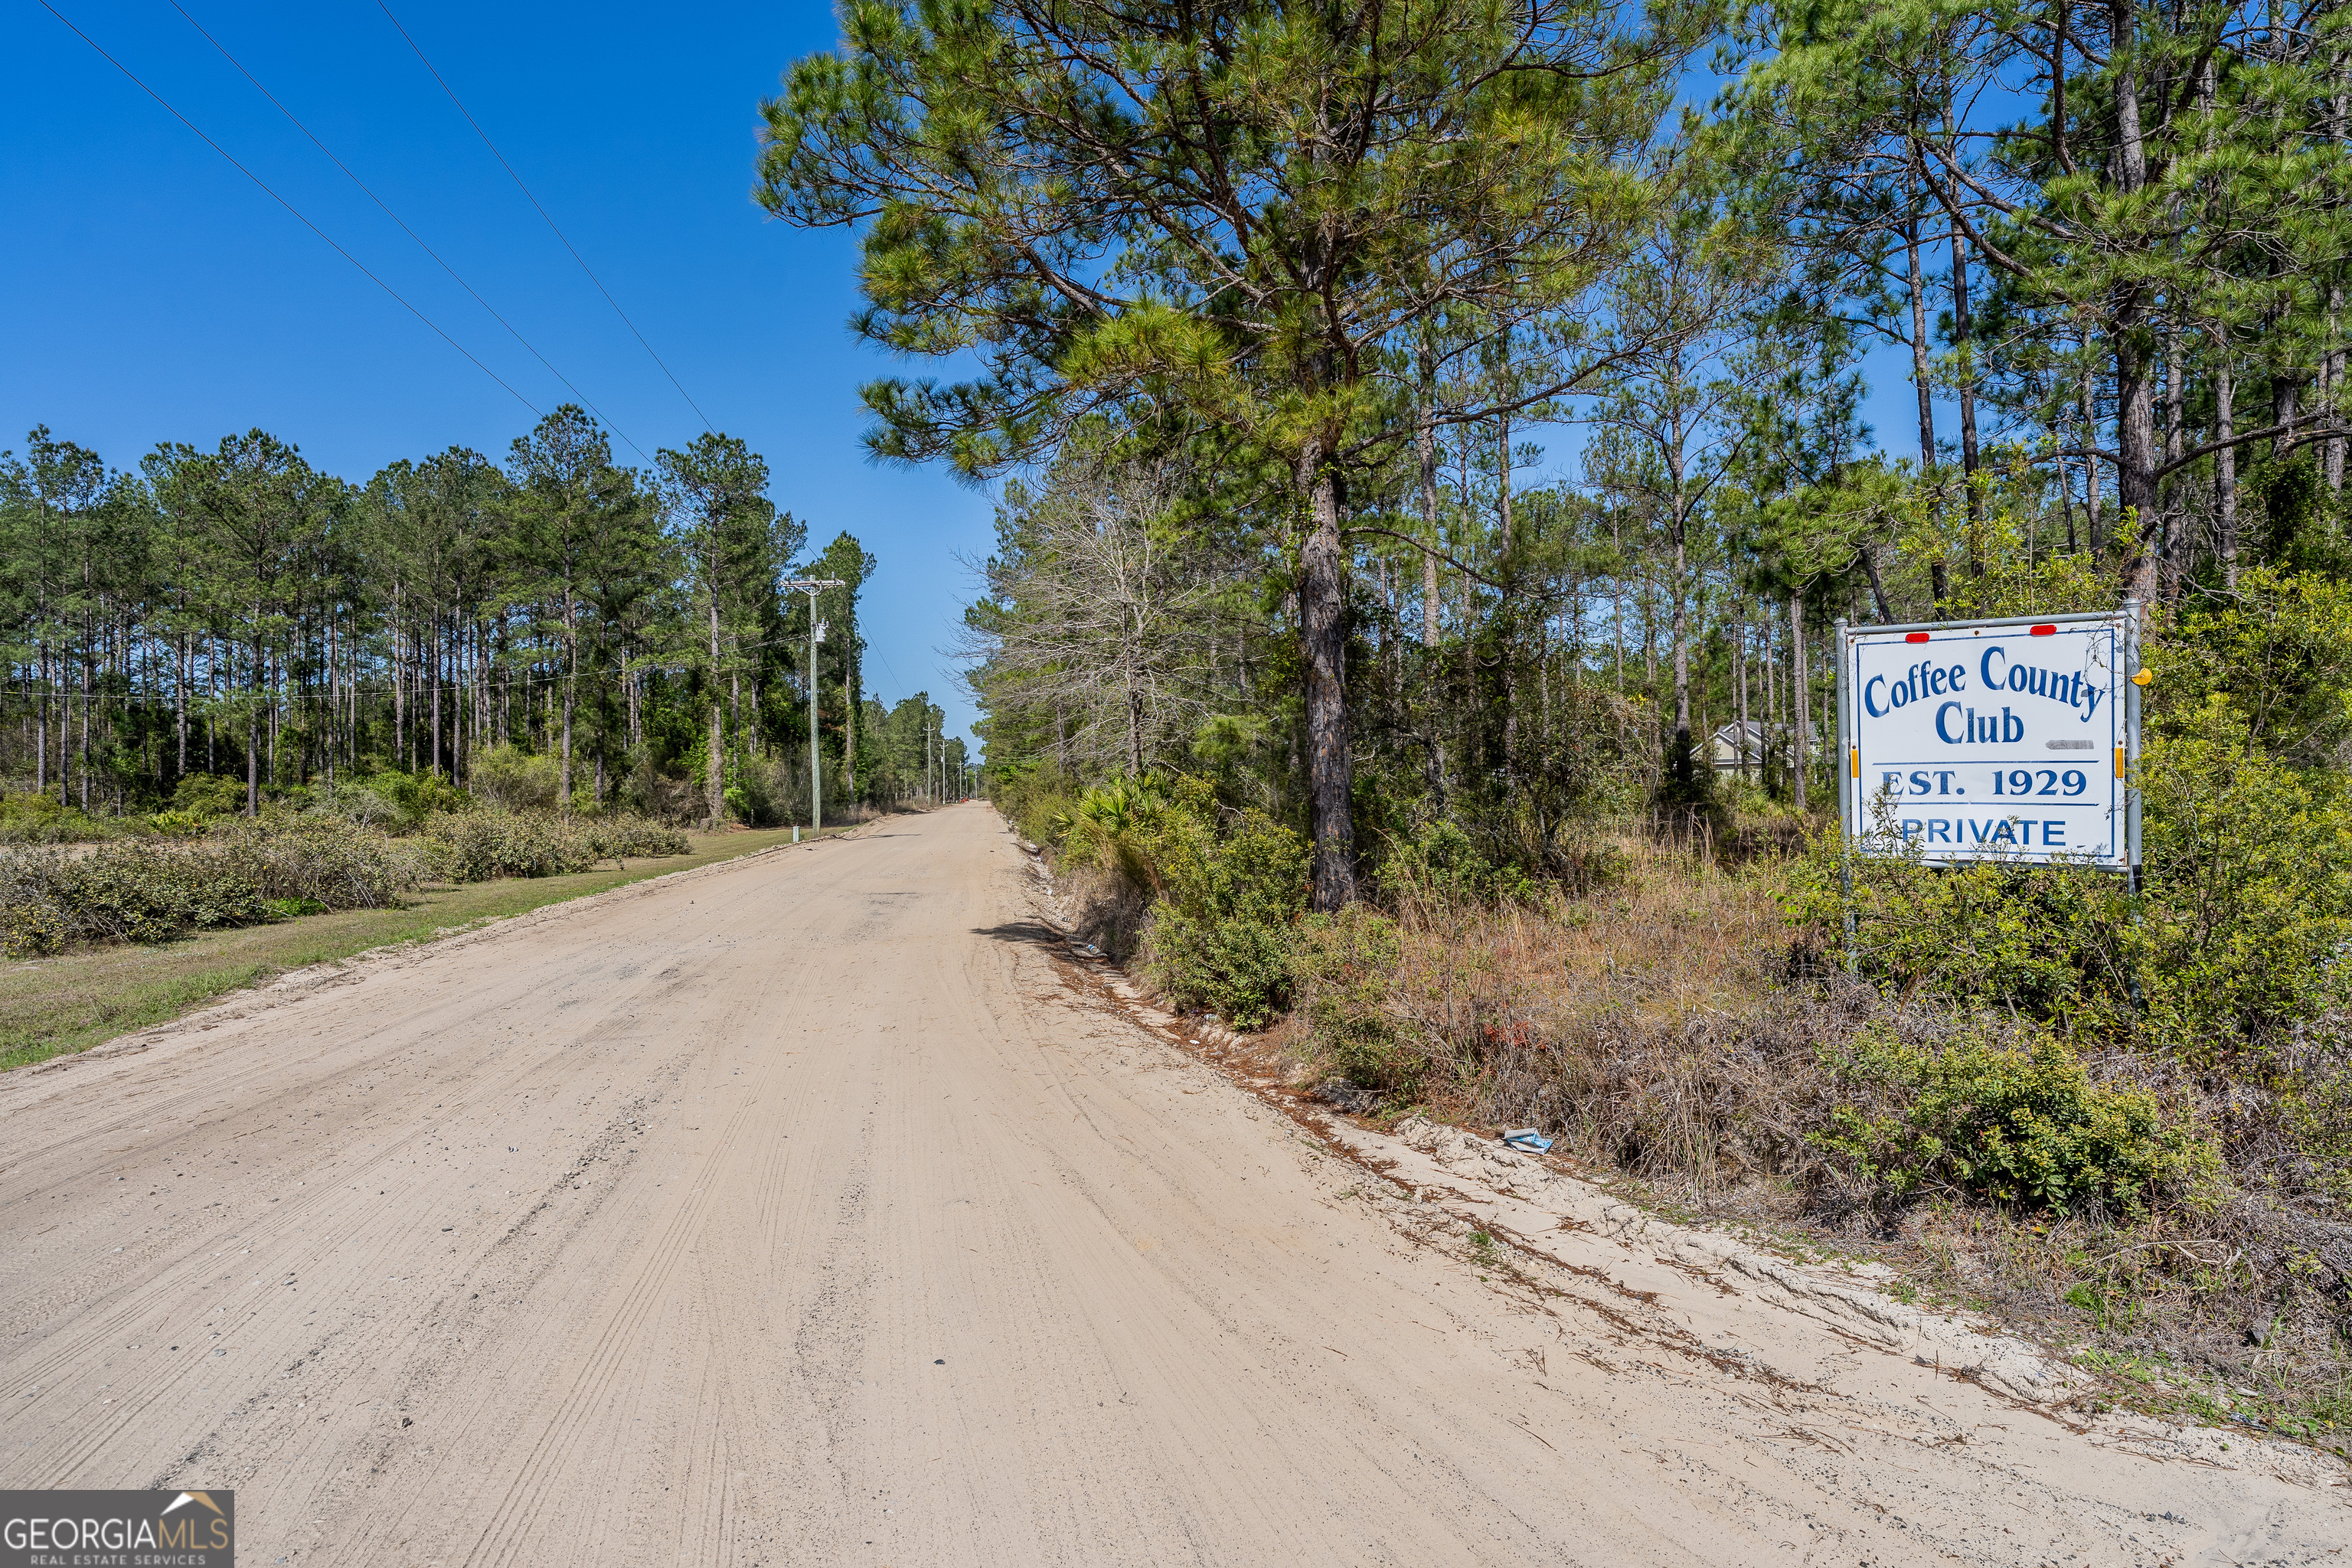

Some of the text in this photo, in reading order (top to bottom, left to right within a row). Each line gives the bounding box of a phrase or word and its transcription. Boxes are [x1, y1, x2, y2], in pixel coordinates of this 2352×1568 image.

[1864, 646, 2105, 723] Coffee County
[1935, 701, 2024, 744] Club
[1881, 769, 2087, 796] EST. 1929
[1902, 818, 2066, 846] PRIVATE
